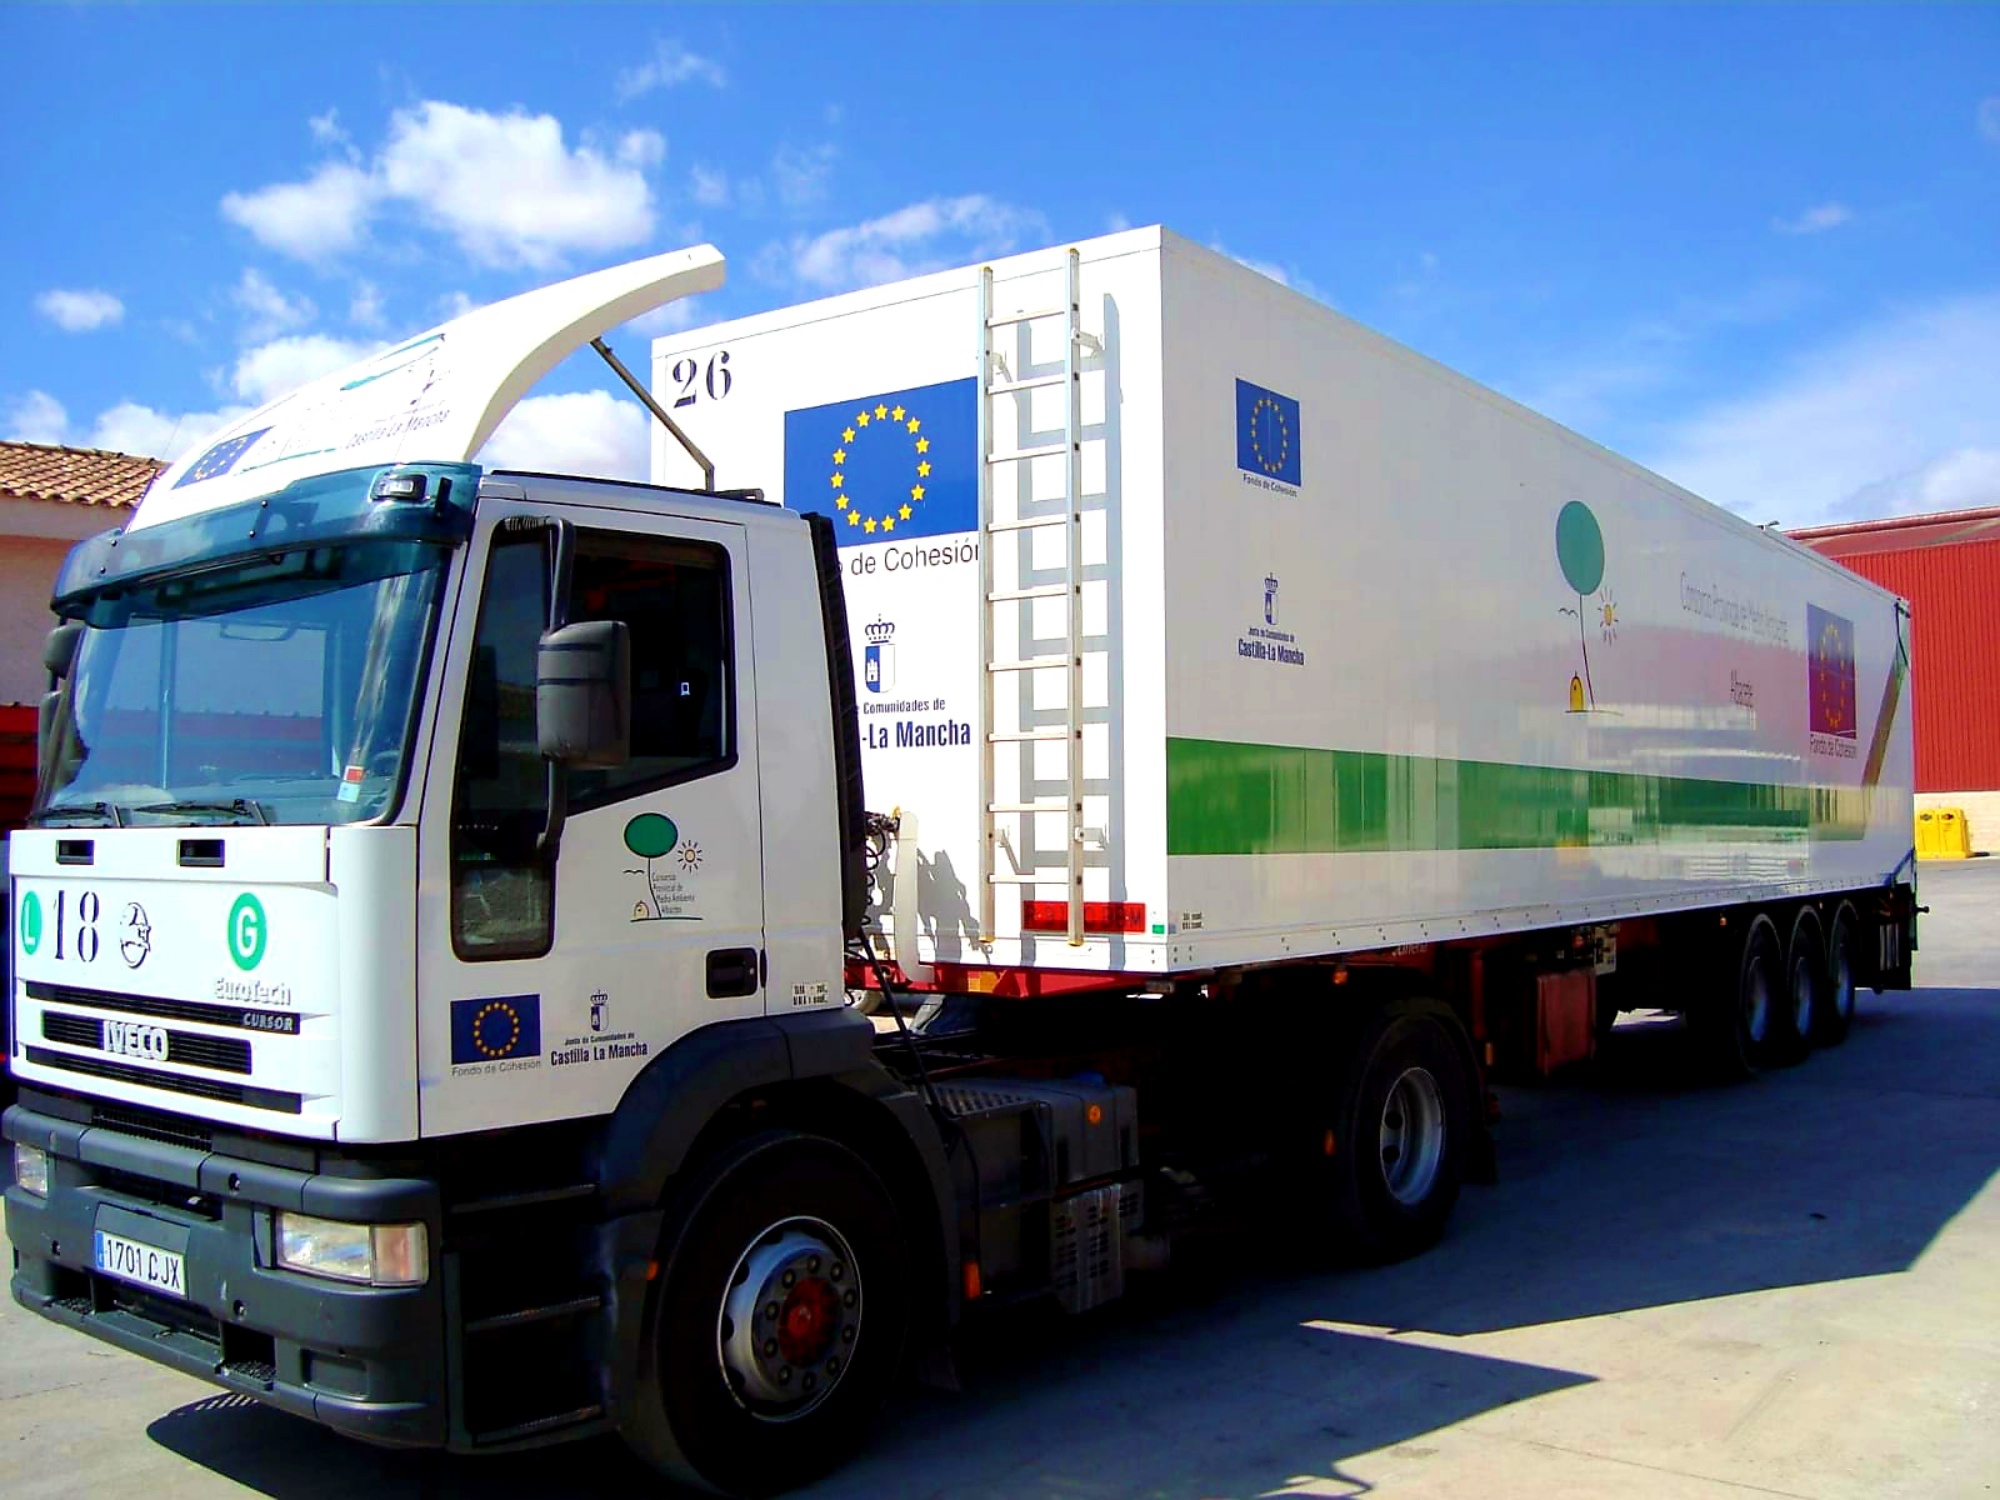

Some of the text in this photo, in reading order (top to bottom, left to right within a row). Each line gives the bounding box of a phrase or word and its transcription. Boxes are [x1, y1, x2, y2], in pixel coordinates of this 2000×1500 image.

[673, 351, 731, 408] 26
[851, 552, 876, 575] de
[1278, 645, 1304, 666] Mancha
[863, 697, 946, 715] Comunidades de
[896, 719, 971, 748] Mancha
[53, 890, 100, 962] 18
[236, 905, 259, 959] G
[242, 1012, 294, 1031] CURSOR
[103, 1019, 170, 1062] IVECO
[550, 1041, 648, 1066] Castilla La Mancha
[107, 1239, 181, 1290] 1701 CJX
